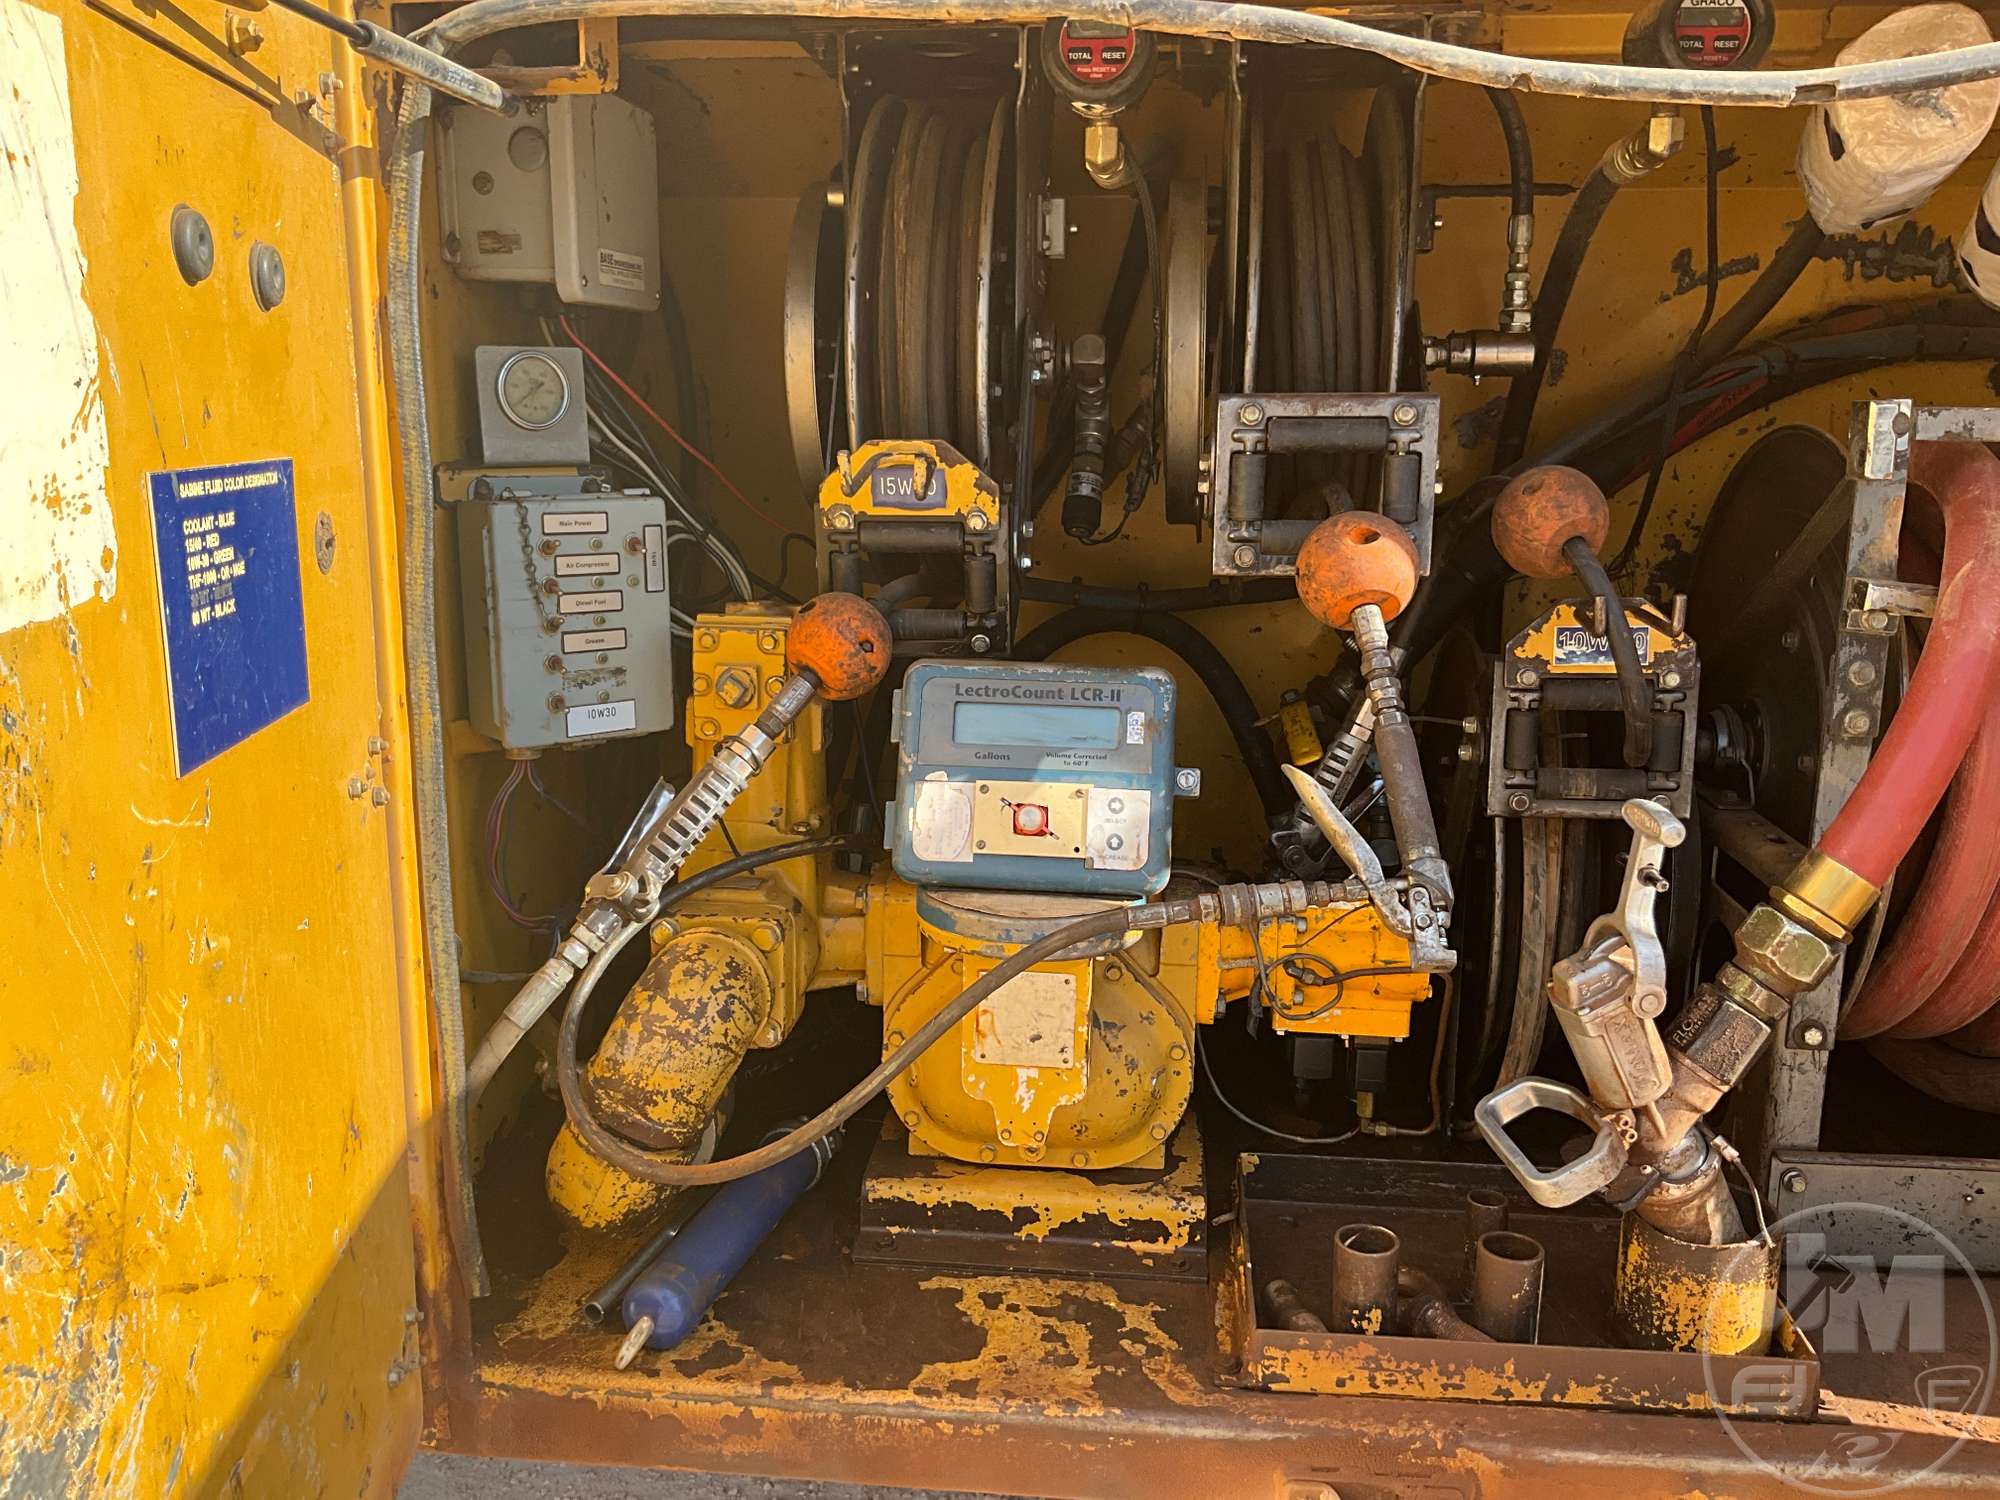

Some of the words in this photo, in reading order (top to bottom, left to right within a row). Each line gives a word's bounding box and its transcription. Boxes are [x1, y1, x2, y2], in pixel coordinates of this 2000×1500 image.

[1679, 40, 1704, 48] TOTAL
[1714, 40, 1740, 48] RESET
[1068, 52, 1092, 60] TOTAL
[1102, 52, 1126, 60] RESET
[205, 479, 224, 495] FLUID
[224, 476, 244, 491] COLOR
[184, 516, 214, 535] COOLANT
[218, 512, 236, 527] BLUE
[205, 533, 220, 548] RED
[213, 547, 235, 564] GREEN
[215, 599, 236, 618] BLACK
[584, 637, 605, 645] Grease
[954, 682, 1065, 701] LectroCount
[1070, 687, 1121, 702] LCR-II
[587, 706, 617, 720] 10W30
[974, 751, 1011, 762] Gallons
[1046, 751, 1071, 761] Volume
[1073, 751, 1108, 762] Corrected
